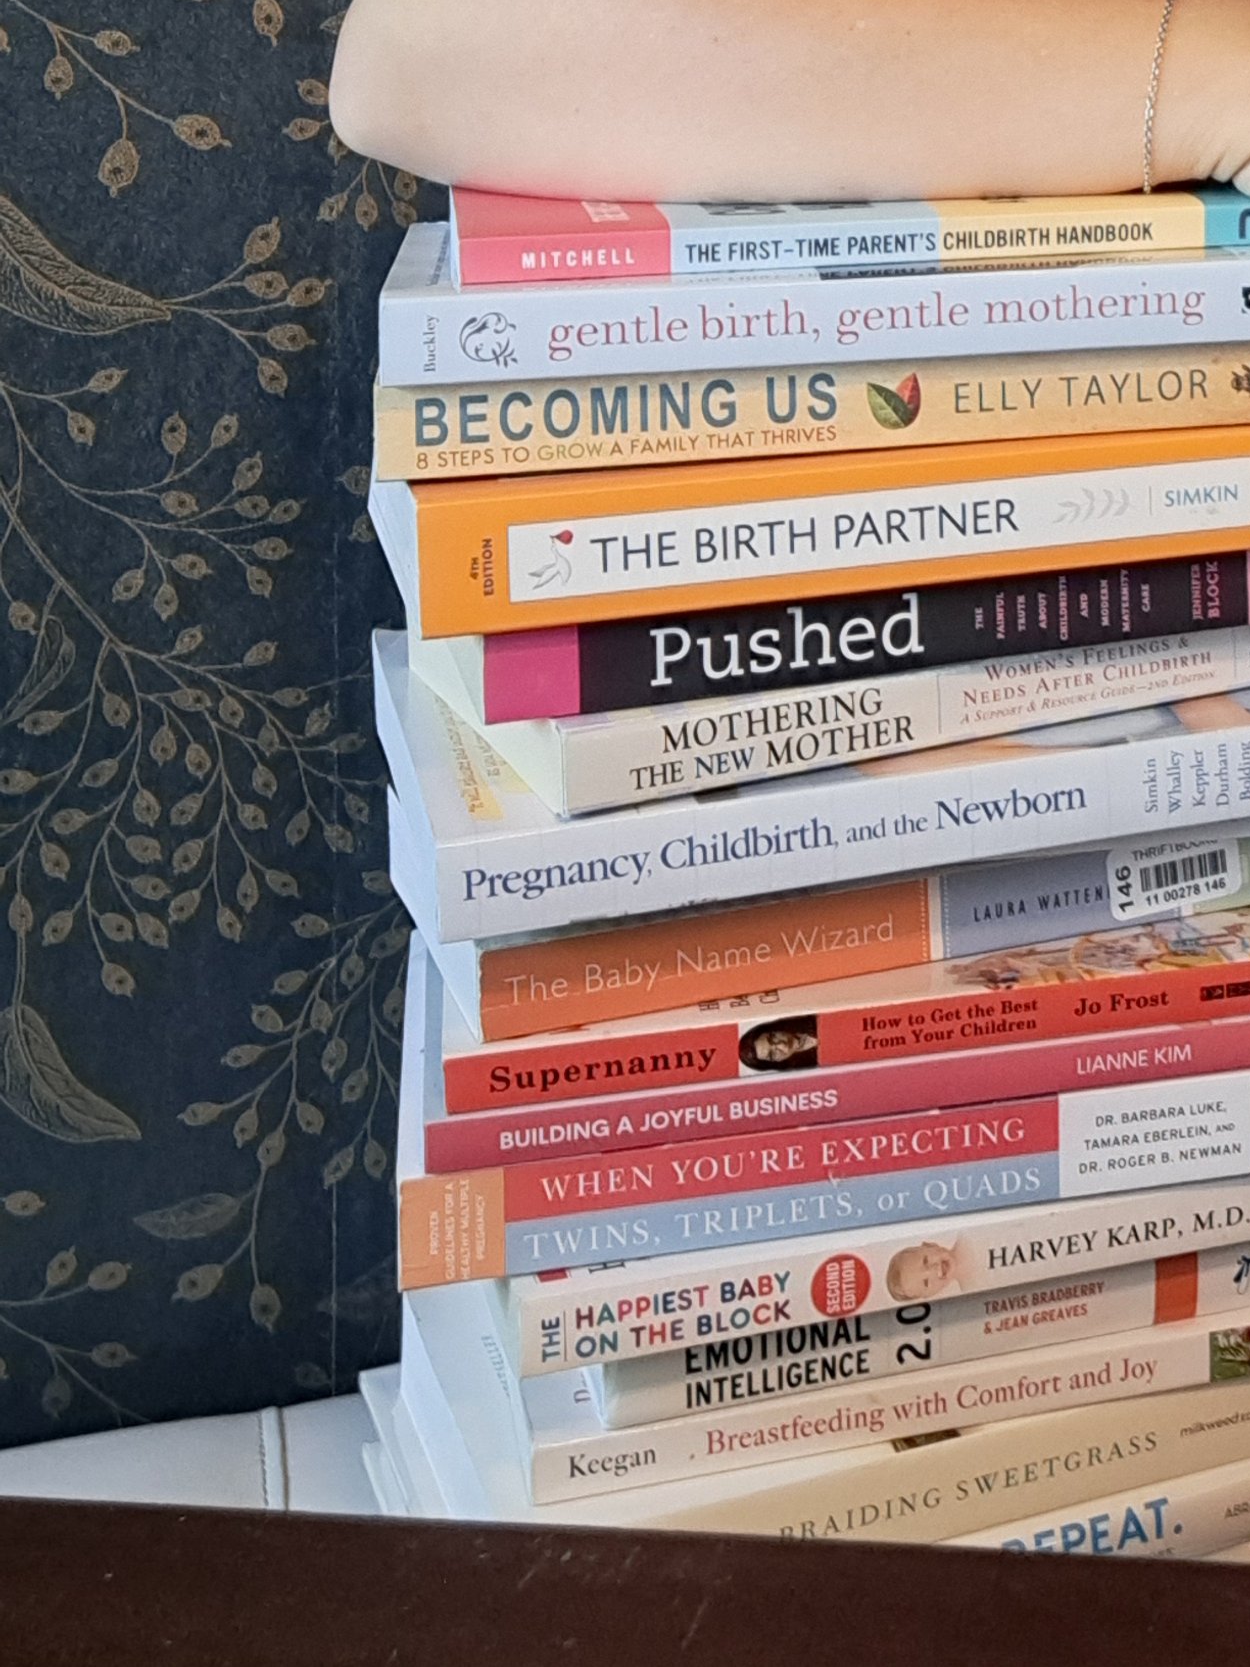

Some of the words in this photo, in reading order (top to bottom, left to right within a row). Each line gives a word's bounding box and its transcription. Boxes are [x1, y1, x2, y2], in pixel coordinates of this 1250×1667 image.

[521, 248, 636, 269] MITCHELL
[685, 243, 721, 264] THE
[728, 237, 840, 261] FIRST-TIME
[847, 231, 937, 255] PARENT'S
[943, 227, 1050, 251] CHILDBIRTH
[1056, 222, 1154, 245] HANDBOOK
[423, 314, 441, 373] Buckley
[548, 304, 688, 362] gentle
[698, 298, 821, 342] birth,
[836, 290, 969, 346] gentle
[984, 281, 1206, 327] mothering
[414, 378, 738, 448] BECOMING
[766, 372, 838, 425] US
[954, 378, 1043, 414] ELLY
[1058, 368, 1208, 408] TAYLOR
[416, 452, 428, 470] 8
[437, 449, 495, 469] STEPS
[502, 446, 530, 464] TO
[537, 441, 604, 462] GROW
[610, 439, 623, 456] A
[630, 436, 701, 455] FAMILY
[707, 431, 755, 450] THAT
[760, 425, 837, 445] THRIVES
[1164, 484, 1239, 508] SIMKIN
[589, 530, 680, 574] THE
[694, 517, 817, 564] BIRTH
[834, 498, 1020, 550] PARTNER
[482, 537, 495, 597] EDITION
[1191, 563, 1201, 620] JENNIFER
[1207, 560, 1219, 620] BLOCK
[974, 606, 984, 631] THE
[995, 591, 1006, 639] PAINFUL
[1018, 594, 1026, 632] TRUTH
[1038, 591, 1048, 630] ABOUT
[1059, 575, 1069, 640] CHILDBIRTH
[1080, 592, 1089, 620] AND
[1101, 579, 1110, 627] MODERN
[1121, 568, 1131, 633] MATERNITY
[1141, 583, 1151, 613] CARE
[649, 592, 925, 687] Pushed
[1083, 636, 1170, 666] FEELINGS
[1178, 636, 1189, 650] &
[962, 684, 1027, 709] NEEDS
[1035, 674, 1095, 695] AFTER
[1102, 651, 1213, 683] CHILDBIRTH
[661, 687, 883, 754] MOTHERING
[630, 760, 684, 791] THE
[694, 746, 756, 780] NEW
[765, 714, 915, 769] MOTHER
[1192, 748, 1206, 808] Keppler
[1215, 742, 1229, 808] Durham
[1142, 757, 1159, 814] Simkin
[1165, 749, 1185, 815] Whalley
[462, 850, 654, 902] Pregnancy,
[660, 816, 839, 872] Childbirth,
[846, 817, 887, 844] and
[892, 812, 928, 836] the
[935, 786, 1088, 831] Newborn
[973, 899, 1027, 923] LAURA
[1115, 865, 1135, 913] 146
[1145, 894, 1160, 907] 11
[1164, 884, 1201, 902] 00278
[504, 974, 569, 1007] The
[584, 958, 663, 992] Baby
[676, 941, 772, 977] Name
[780, 913, 894, 958] Wizard
[861, 1015, 903, 1032] How
[908, 1011, 926, 1026] to
[930, 1008, 962, 1024] Get
[966, 1004, 997, 1020] the
[1000, 999, 1040, 1015] Best
[1074, 997, 1102, 1017] Jo
[1110, 990, 1170, 1013] Frost
[862, 1033, 907, 1051] from
[911, 1027, 956, 1044] Your
[960, 1018, 1038, 1039] Children
[1077, 1048, 1149, 1075] LIANNE
[1154, 1044, 1192, 1063] KIM
[489, 1044, 718, 1094] Supernanny
[500, 1118, 611, 1151] BUILDING
[616, 1116, 634, 1134] A
[640, 1105, 723, 1132] JOYFUL
[729, 1089, 839, 1120] BUSINESS
[1084, 1134, 1139, 1151] TAMARA
[1144, 1125, 1212, 1145] EBERLEIN,
[1216, 1122, 1236, 1134] AND
[1095, 1114, 1118, 1127] DR.
[1122, 1106, 1186, 1124] BARBARA
[1190, 1101, 1228, 1116] LUKE,
[540, 1164, 655, 1202] WHEN
[671, 1146, 806, 1184] YOU'RE
[821, 1117, 1027, 1166] EXPECTING
[1079, 1160, 1102, 1174] DR.
[1108, 1153, 1156, 1170] ROGER
[1161, 1150, 1175, 1164] B.
[1180, 1143, 1242, 1161] NEWMAN
[523, 1219, 661, 1260] TWINS,
[675, 1192, 863, 1241] TRIPLETS,
[877, 1190, 910, 1211] or
[924, 1167, 1042, 1210] QUADS
[987, 1232, 1097, 1270] HARVEY
[1107, 1217, 1183, 1249] KARP,
[1192, 1206, 1250, 1233] M.D.
[575, 1285, 710, 1329] HAPPIEST
[720, 1271, 791, 1304] BABY
[826, 1262, 840, 1314] SECOND
[842, 1259, 856, 1311] EDITION
[984, 1297, 1028, 1315] TRAVIS
[1032, 1281, 1105, 1306] BRADBERRY
[542, 1317, 561, 1363] THE
[574, 1331, 619, 1359] ON
[630, 1318, 685, 1348] THE
[696, 1299, 792, 1337] BLOCK
[685, 1315, 870, 1375] EMOTIONAL
[895, 1301, 932, 1366] 2.0
[984, 1321, 993, 1335] &
[996, 1313, 1029, 1333] JEAN
[1033, 1303, 1088, 1326] GREAVES
[685, 1348, 870, 1409] INTELLIGENCE
[706, 1406, 886, 1455] Breastfeeding
[893, 1390, 948, 1420] with
[956, 1375, 1062, 1410] Comfort
[1069, 1362, 1113, 1391] and
[1119, 1357, 1159, 1384] Joy
[568, 1445, 657, 1480] Keegan
[956, 1431, 1159, 1502] SWEETGRASS
